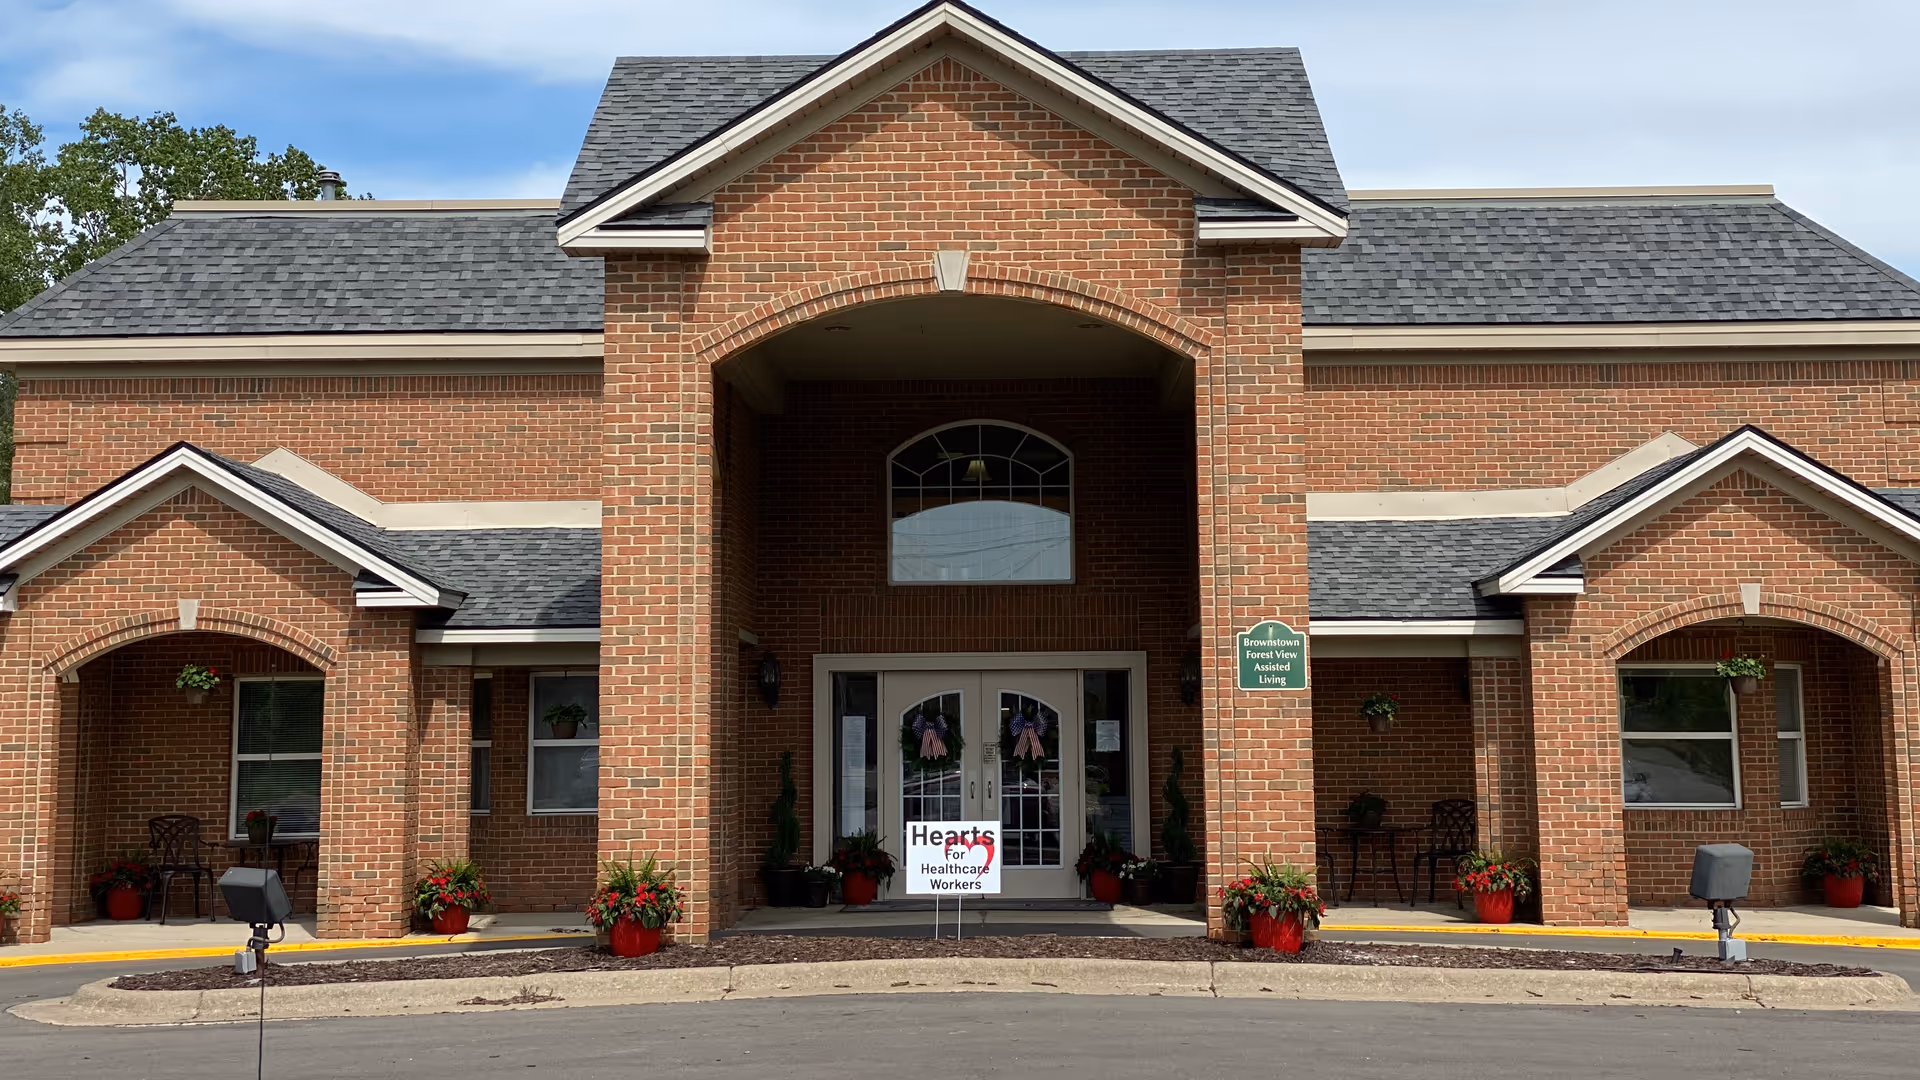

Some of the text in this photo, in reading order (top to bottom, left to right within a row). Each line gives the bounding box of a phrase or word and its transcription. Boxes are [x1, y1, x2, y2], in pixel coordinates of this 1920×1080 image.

[1243, 638, 1300, 647] Brownstown
[1246, 650, 1298, 659] Forest View
[1253, 662, 1291, 671] Assisted
[1259, 675, 1287, 686] Living
[912, 825, 995, 846] Hearts
[946, 849, 966, 859] For
[921, 863, 990, 875] Healthcare
[930, 879, 982, 890] Workers
